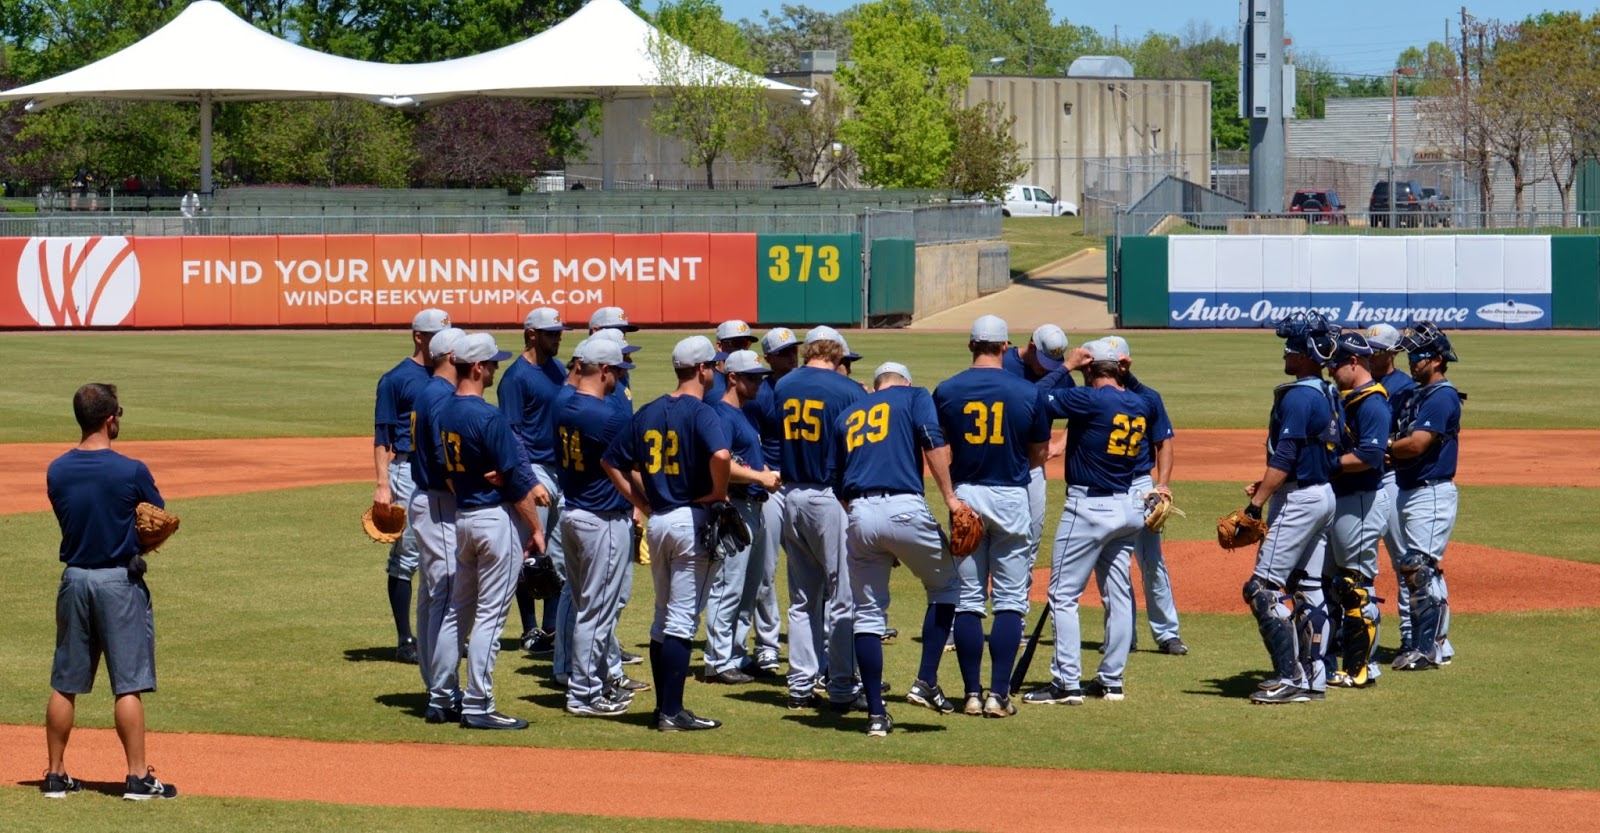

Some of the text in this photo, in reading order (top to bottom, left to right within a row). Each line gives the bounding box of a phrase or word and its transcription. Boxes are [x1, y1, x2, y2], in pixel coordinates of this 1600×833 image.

[182, 256, 703, 285] FIND YOUR WINNING MOMENT
[768, 245, 841, 283] 373
[284, 288, 603, 306] WINDCREEKWETUMPKA.COM
[1171, 298, 1469, 322] Auto-Owners Insurance
[783, 398, 825, 443] 25
[846, 402, 891, 452] 29
[963, 401, 1006, 445] 31
[1106, 413, 1147, 457] 22
[643, 429, 681, 475] 32
